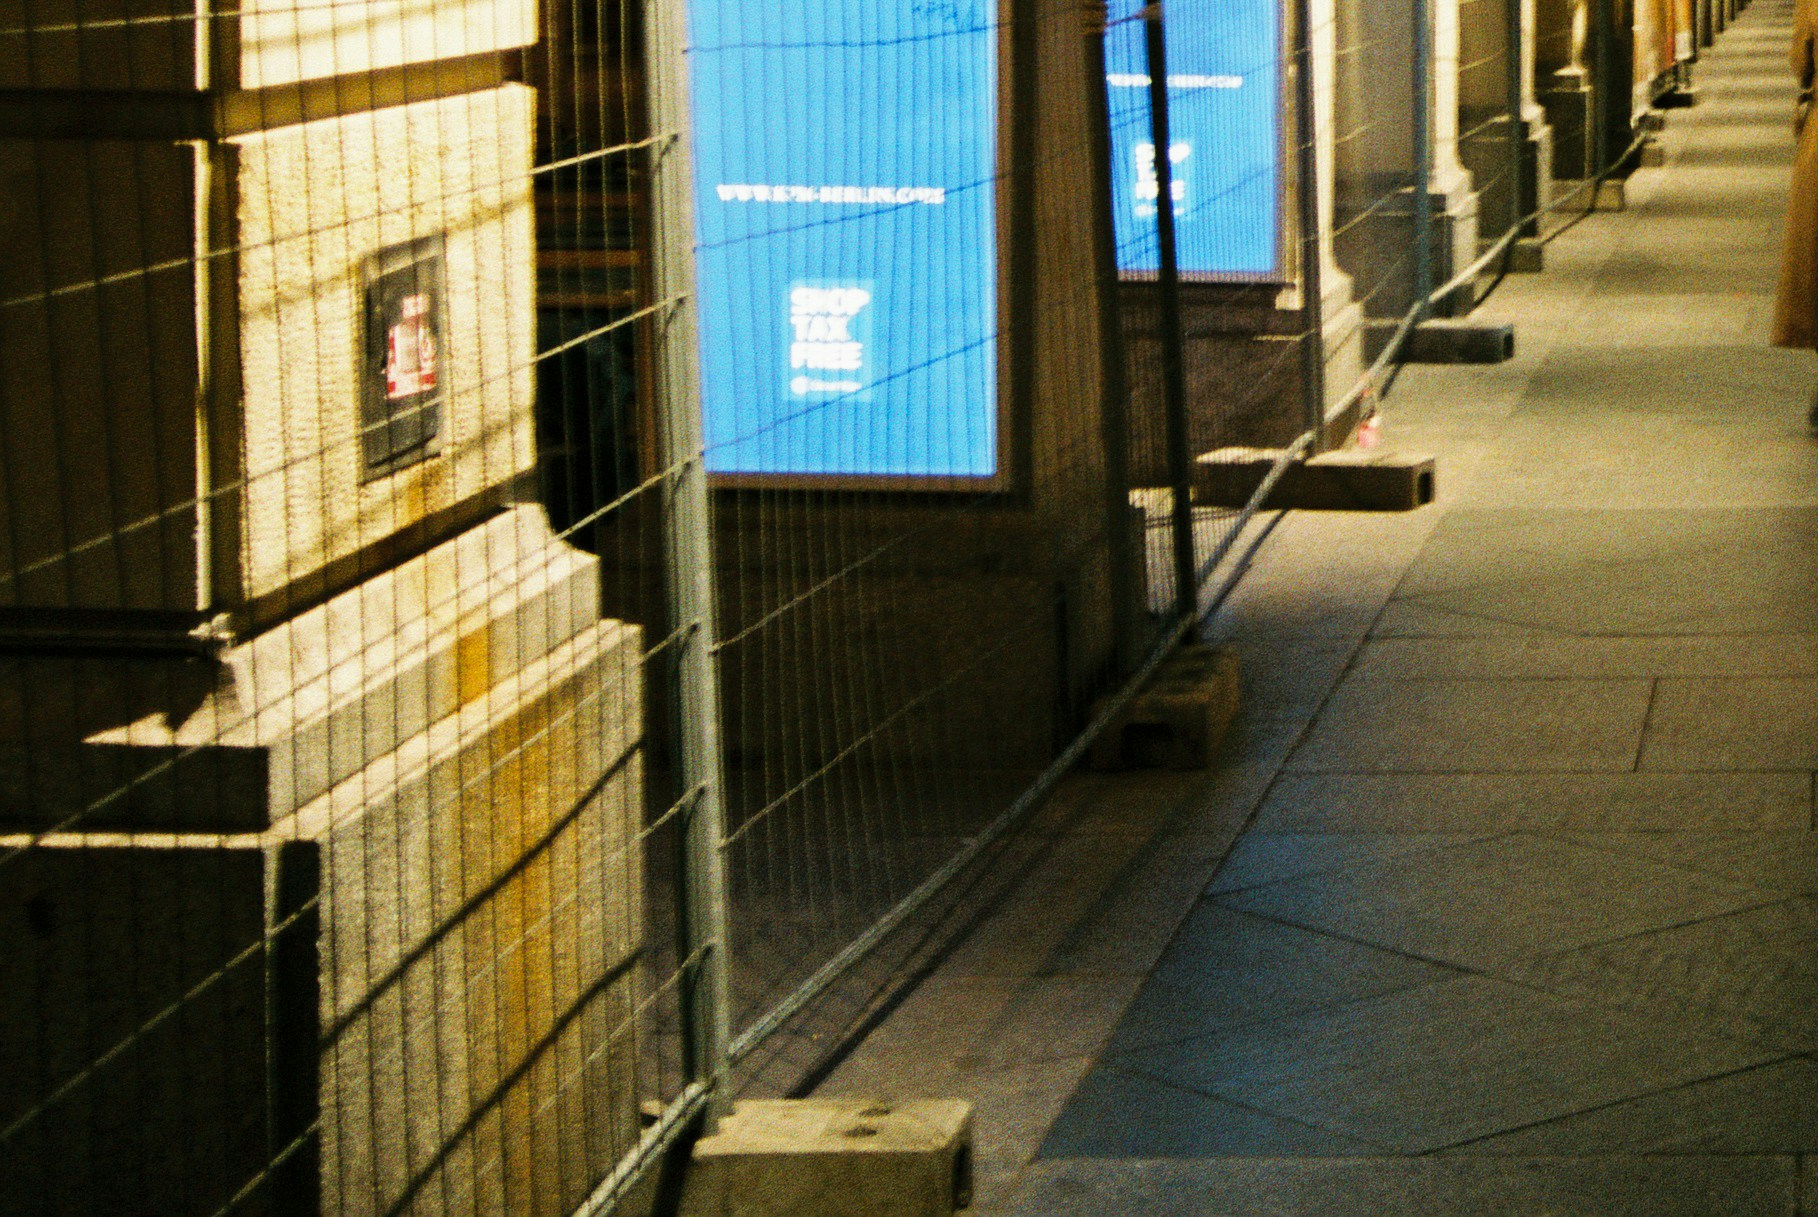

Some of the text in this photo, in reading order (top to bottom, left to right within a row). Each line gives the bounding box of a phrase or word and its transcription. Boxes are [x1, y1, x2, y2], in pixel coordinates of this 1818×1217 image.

[790, 287, 871, 315] SHOP
[790, 315, 852, 341] TAX
[790, 341, 863, 370] FREE
